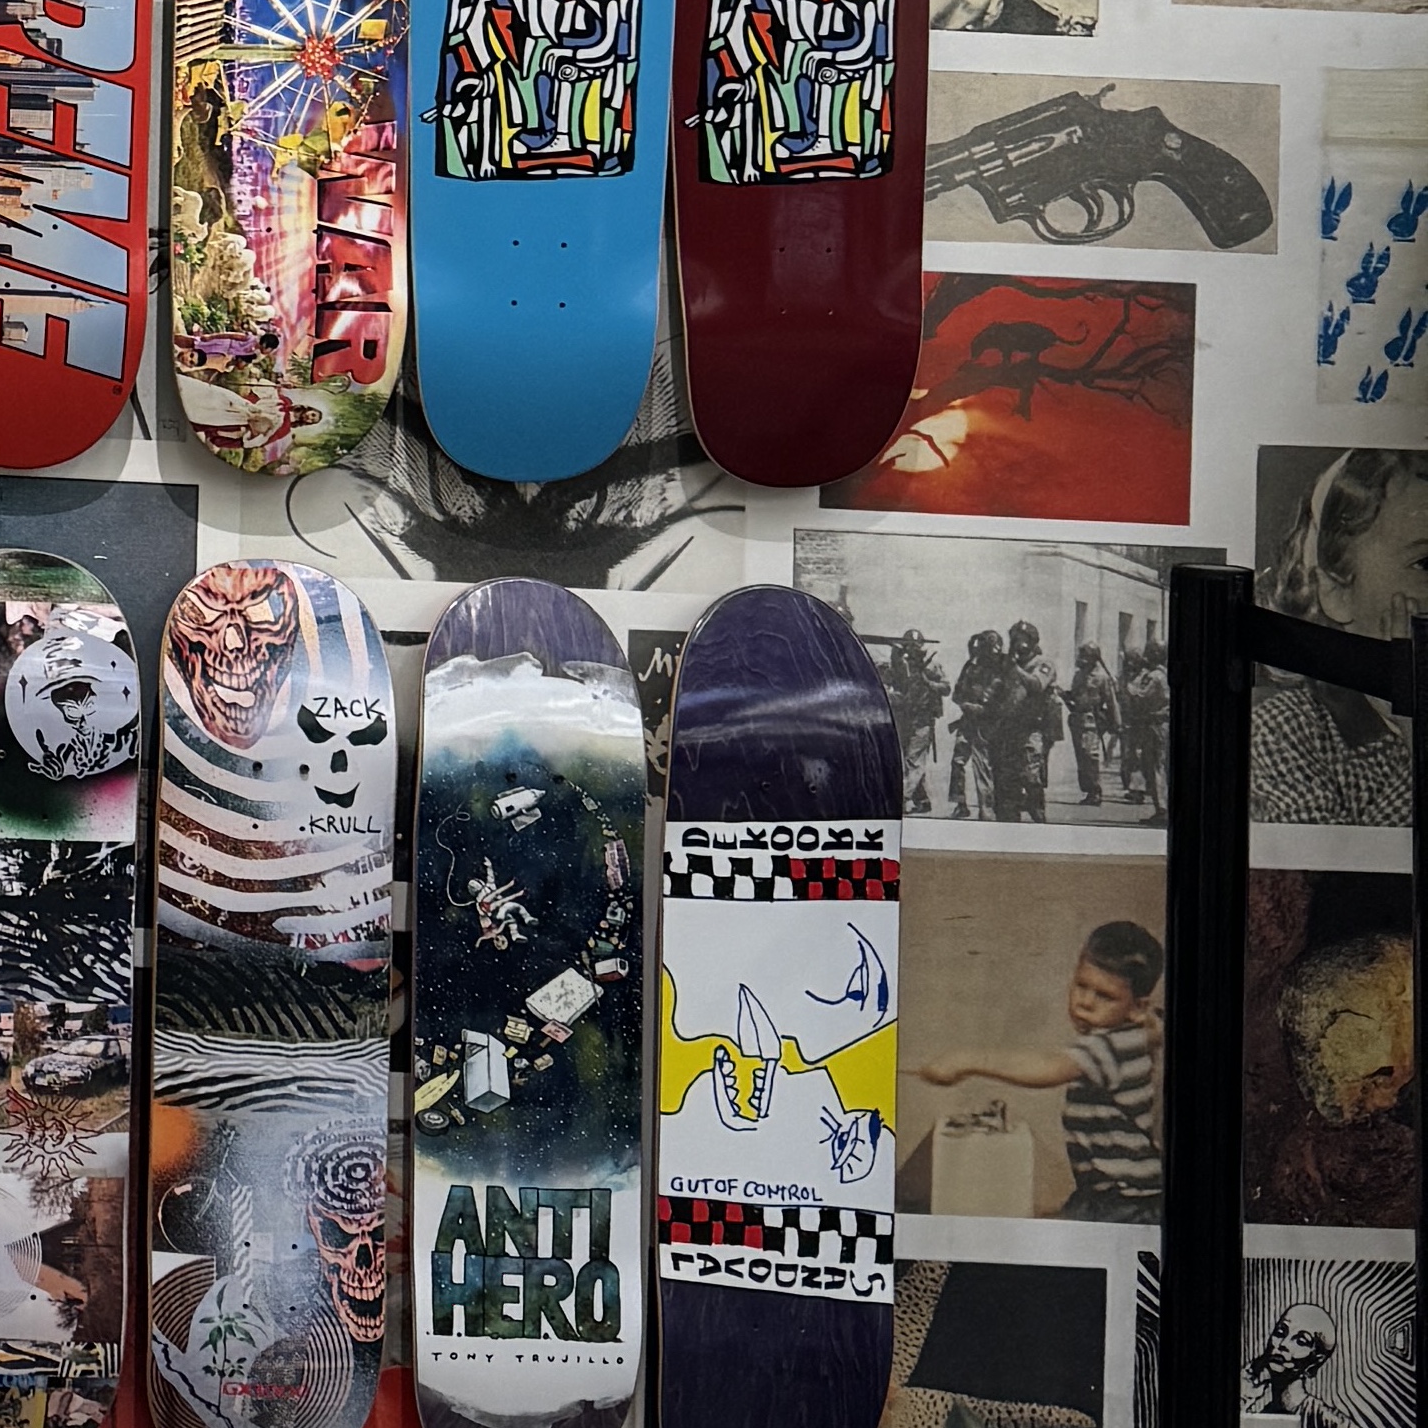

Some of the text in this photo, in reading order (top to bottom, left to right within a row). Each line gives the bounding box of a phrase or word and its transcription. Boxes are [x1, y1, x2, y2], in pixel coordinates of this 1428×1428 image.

[312, 696, 386, 720] ZACK
[308, 814, 382, 834] KRULL
[743, 1180, 824, 1202] CONTROL
[434, 1184, 613, 1260] ANTI
[430, 1249, 624, 1343] HERO
[431, 1351, 625, 1365] TONY TRUJILLO
